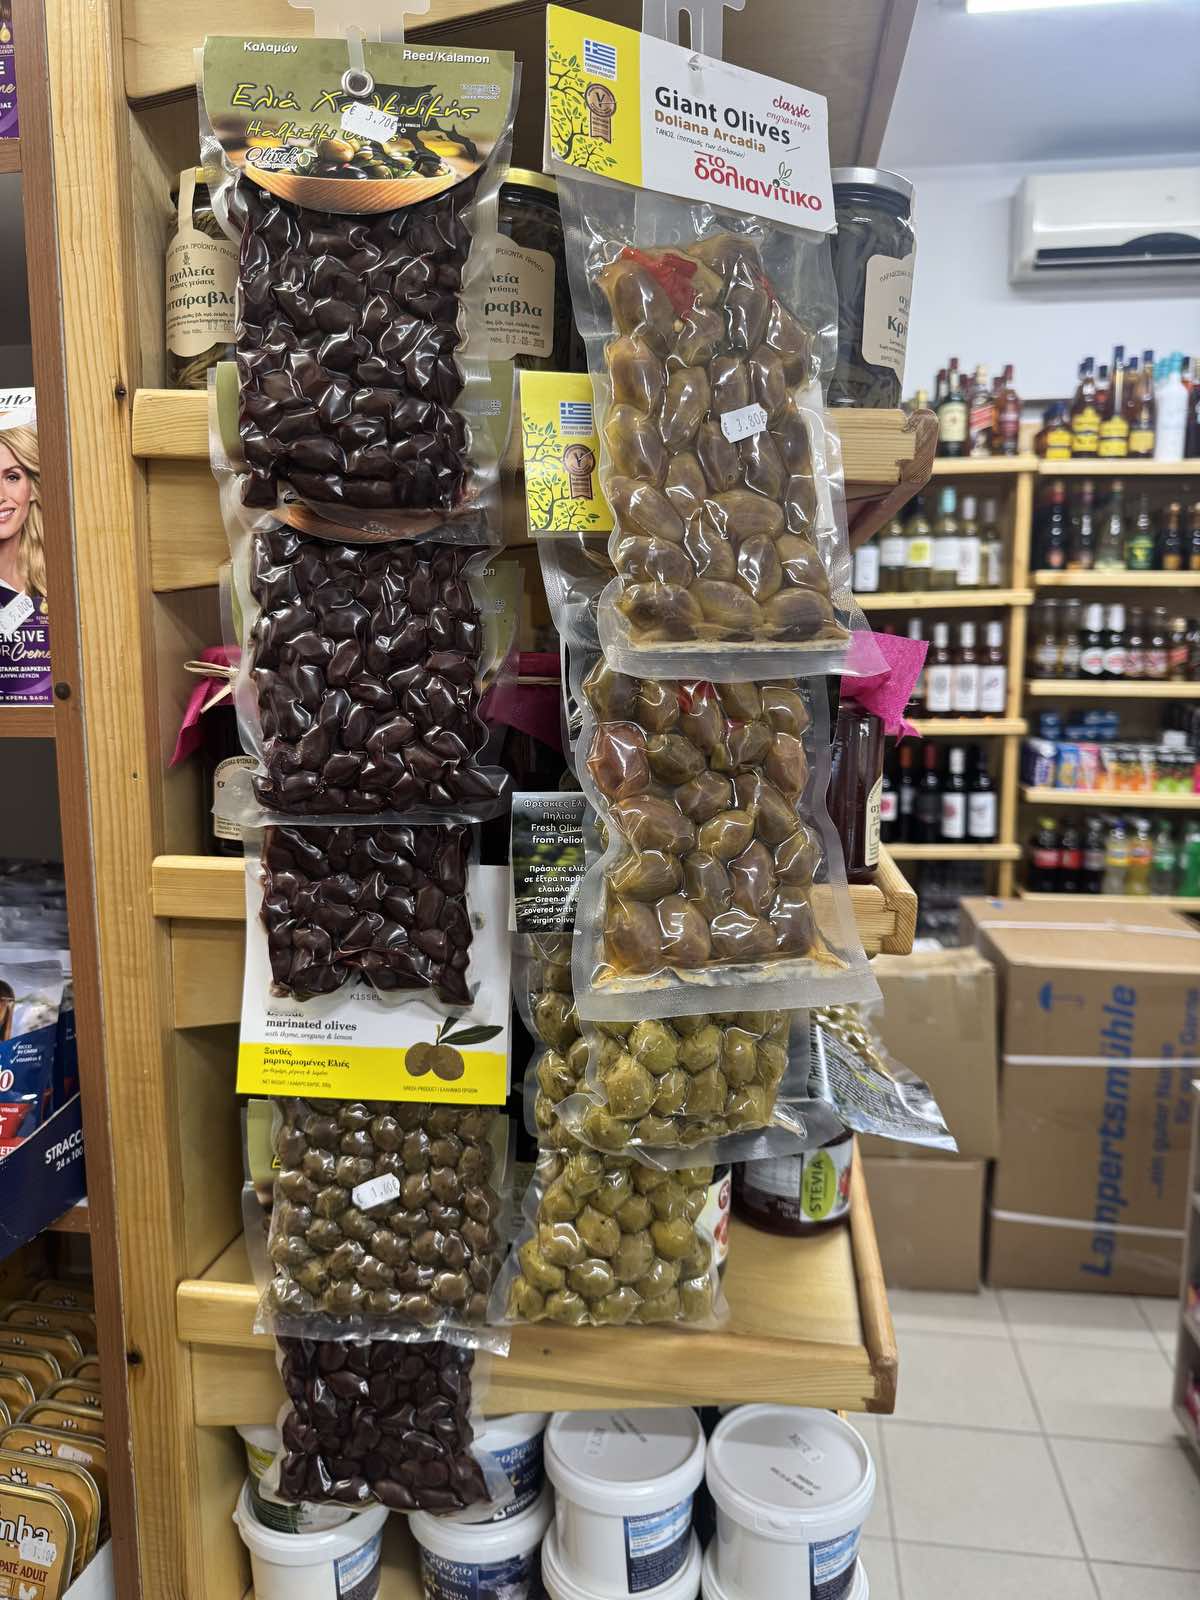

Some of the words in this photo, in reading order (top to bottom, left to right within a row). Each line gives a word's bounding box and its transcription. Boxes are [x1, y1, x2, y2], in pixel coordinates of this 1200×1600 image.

[243, 41, 298, 54] Καλαμών
[403, 49, 490, 63] Reed/Kalamon
[231, 82, 301, 112] Ελιά
[772, 95, 811, 118] classic
[654, 86, 718, 123] Giant
[723, 107, 791, 145] Olives
[766, 111, 811, 132] engravings
[654, 109, 709, 137] Doliana
[713, 127, 766, 154] Arcadia
[543, 811, 577, 822] Πηλίου
[531, 823, 556, 832] Fresh
[558, 824, 583, 832] Olive
[532, 835, 555, 844] from
[529, 865, 567, 873] Πράσινες
[535, 874, 558, 884] έξτρα
[560, 873, 585, 884] παρθέ
[524, 906, 554, 914] covered
[555, 906, 574, 914] with
[532, 916, 554, 926] virgin
[266, 1018, 322, 1030] marinated
[324, 1020, 357, 1032] olives
[1080, 984, 1137, 1278] Lampertsmühle
[45, 1129, 84, 1165] STRACC
[809, 1158, 824, 1214] STEVIA
[20, 1566, 49, 1583] ADULT
